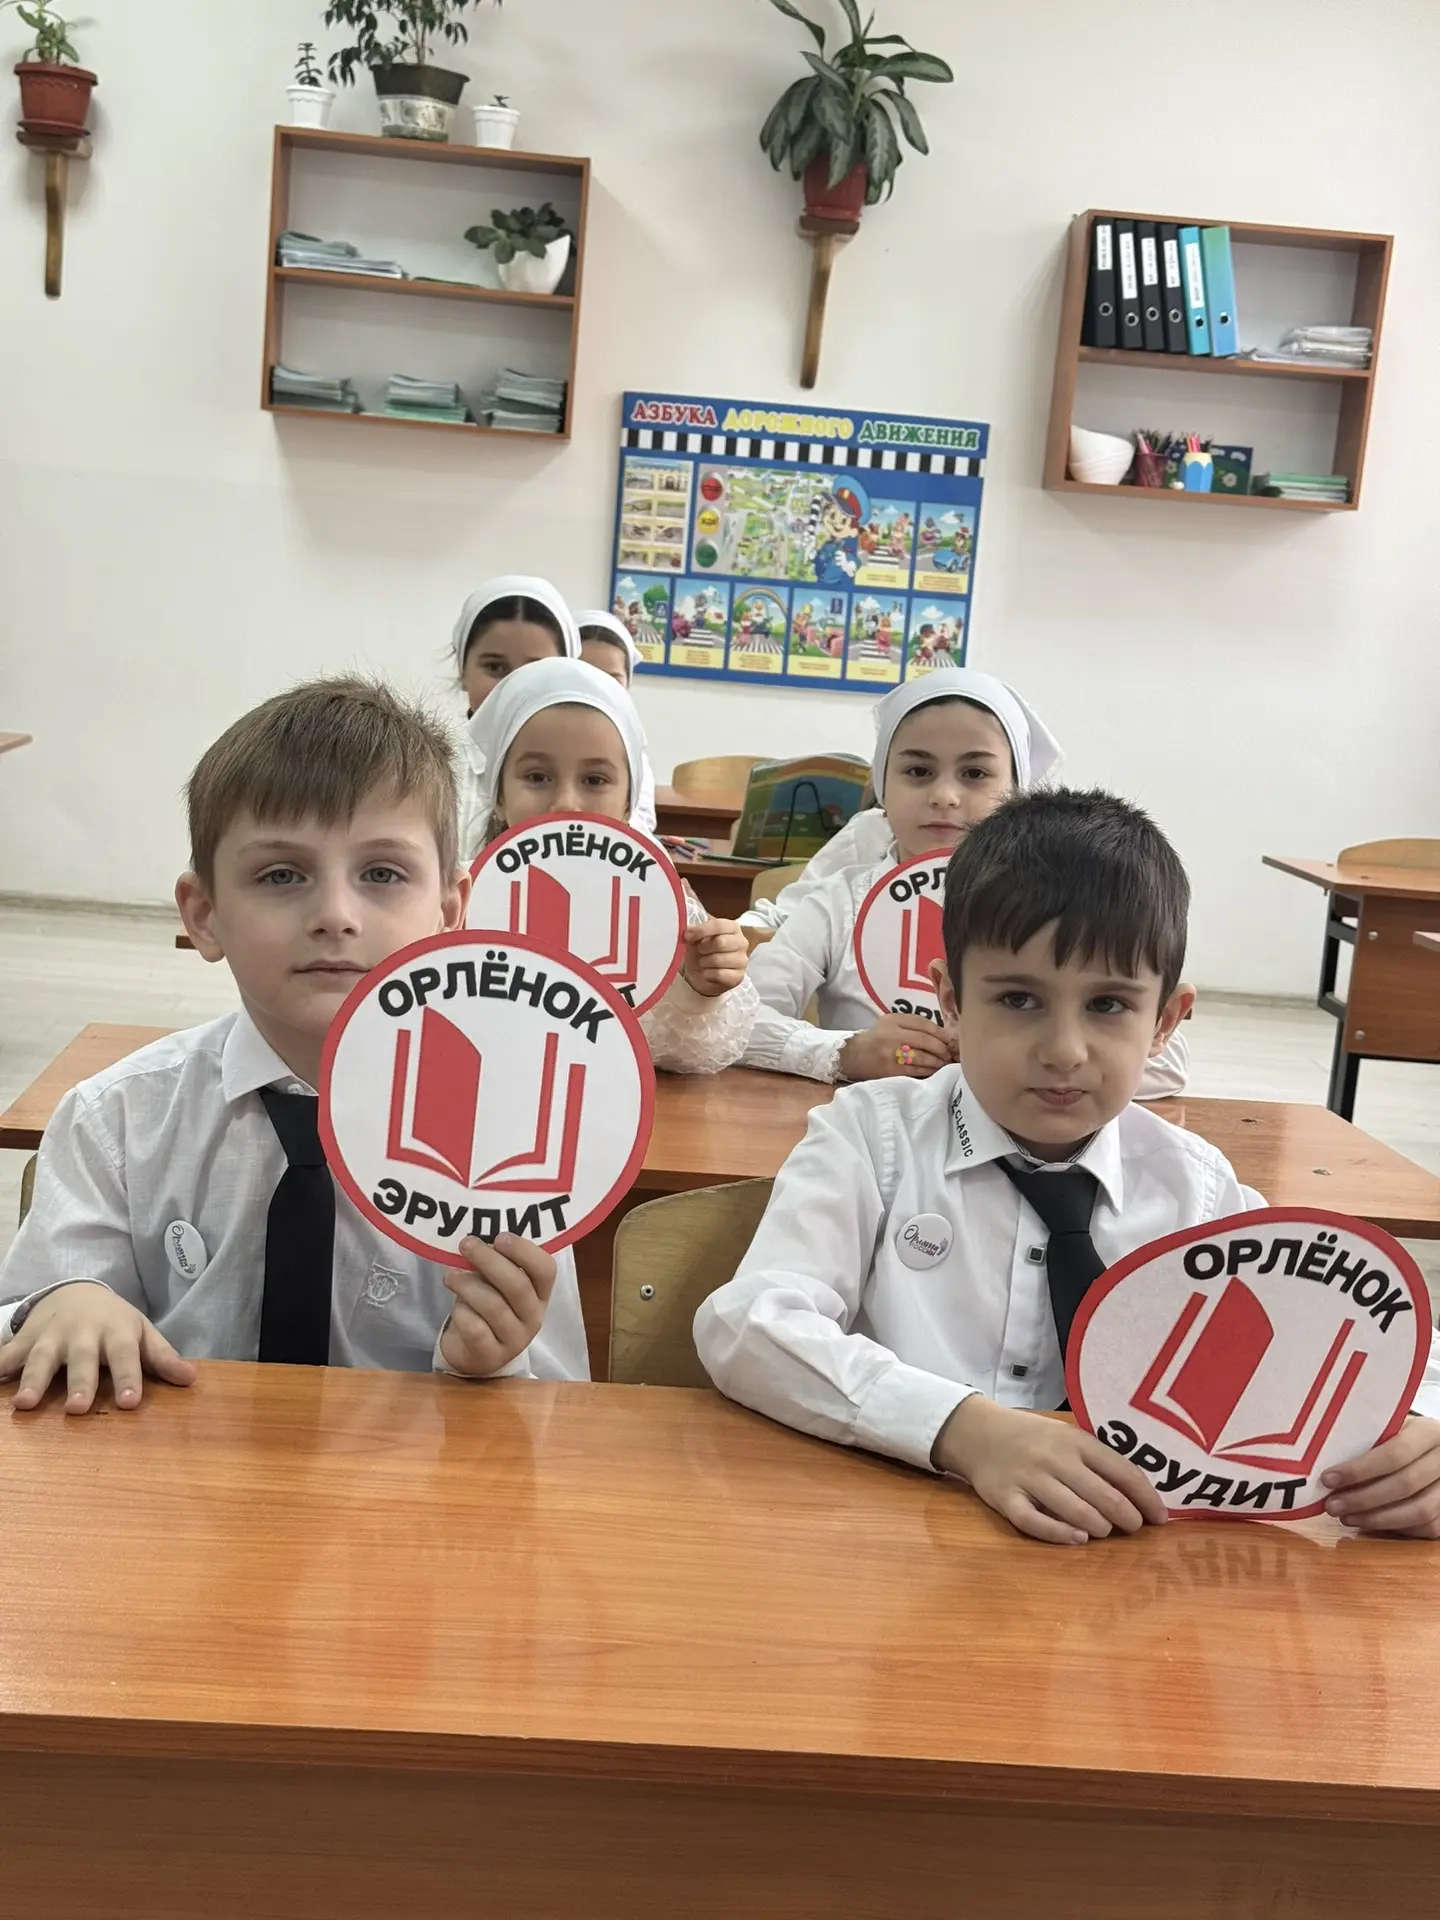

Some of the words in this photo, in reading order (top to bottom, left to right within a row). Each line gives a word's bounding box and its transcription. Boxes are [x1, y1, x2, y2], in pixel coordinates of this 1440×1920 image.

[632, 402, 717, 426] АЗБУКА
[722, 409, 854, 439] ДОРОЖНОГО
[859, 421, 980, 449] ДВИЖЕНИЯ
[496, 824, 657, 882] ОРЛЁНОК
[378, 950, 614, 1044] ОРЛЁНОК
[955, 1110, 974, 1158] CLASSIC
[373, 1178, 572, 1245] ЭРУДИТ
[1183, 1231, 1413, 1333] ОРЛЁНОК
[1097, 1420, 1307, 1510] ЭРУДИТ
